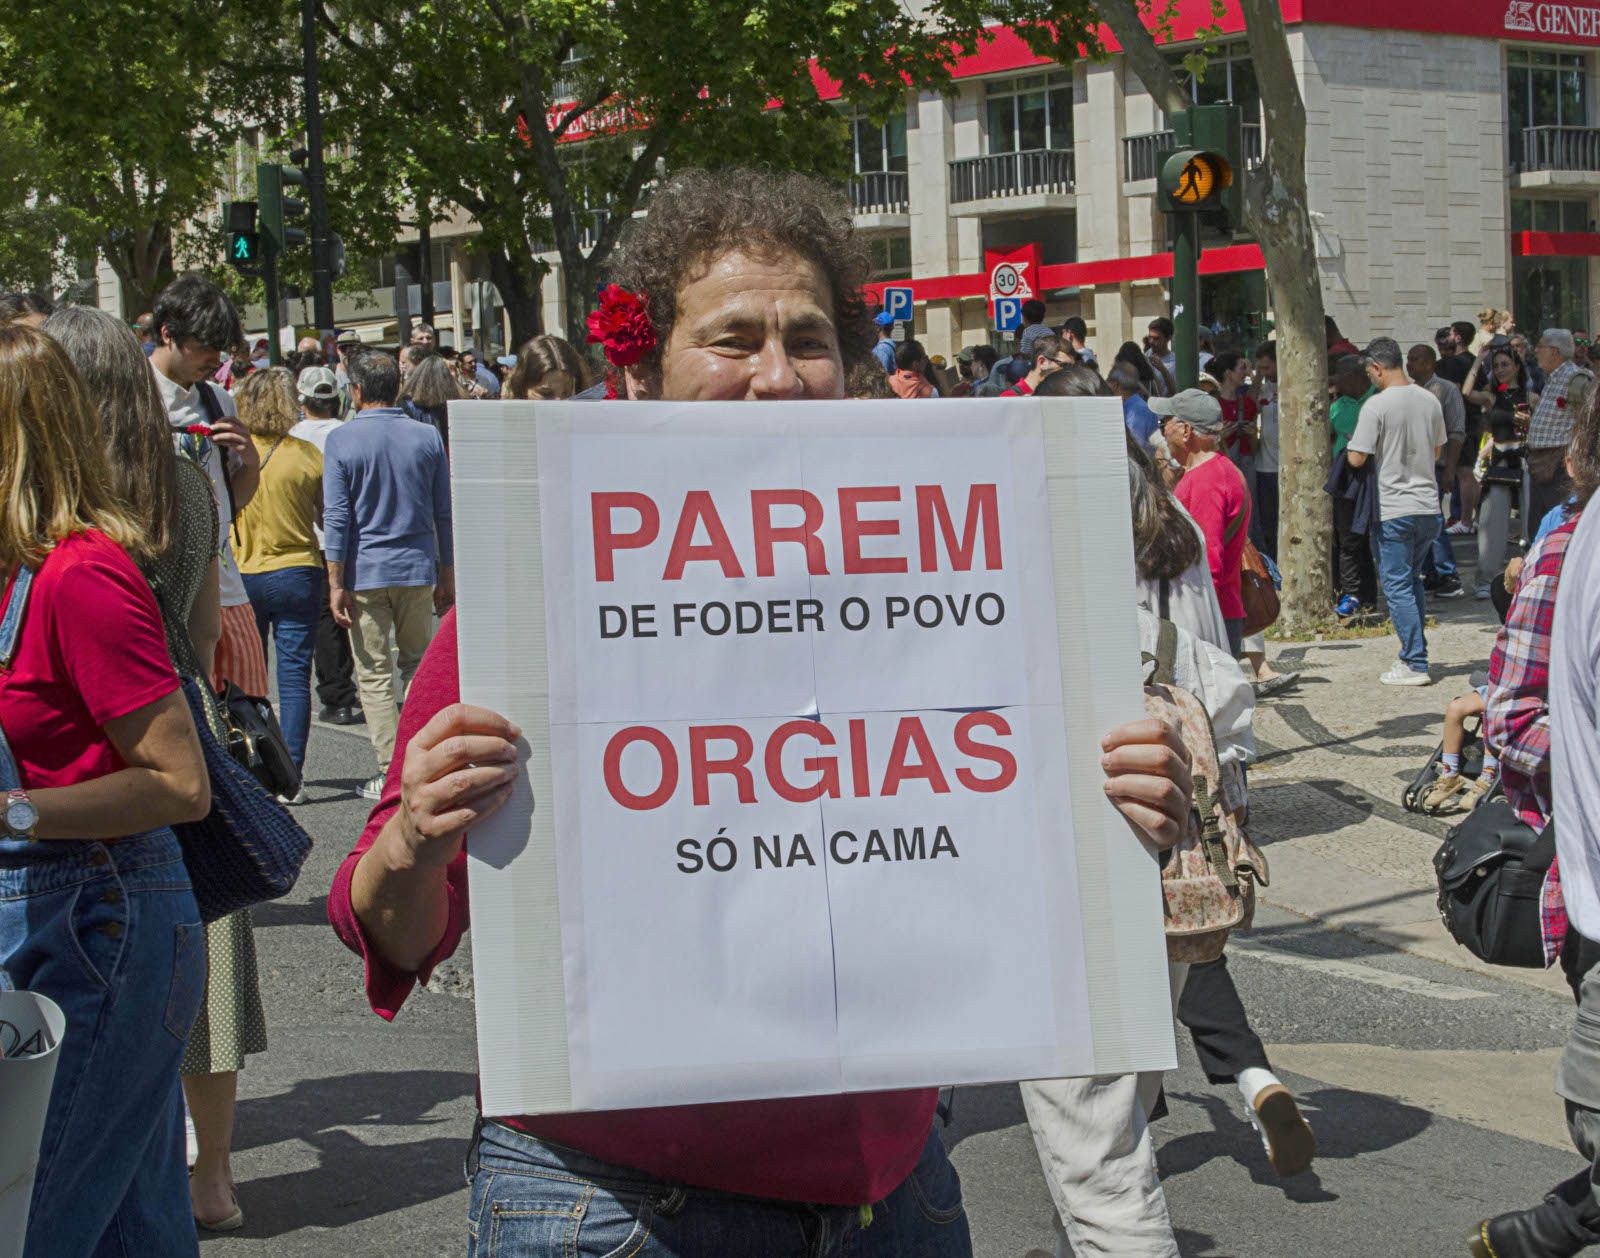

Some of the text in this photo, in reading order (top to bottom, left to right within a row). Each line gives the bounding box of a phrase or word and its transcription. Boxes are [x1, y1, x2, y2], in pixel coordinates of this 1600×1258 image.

[998, 273, 1016, 287] 30
[890, 290, 907, 318] P
[1001, 300, 1017, 328] P
[591, 484, 1003, 582] PAREM
[599, 592, 1006, 639] DE FODER O POVO
[603, 710, 1018, 811] ORGIAS
[676, 825, 960, 874] SÓ NA CAMA
